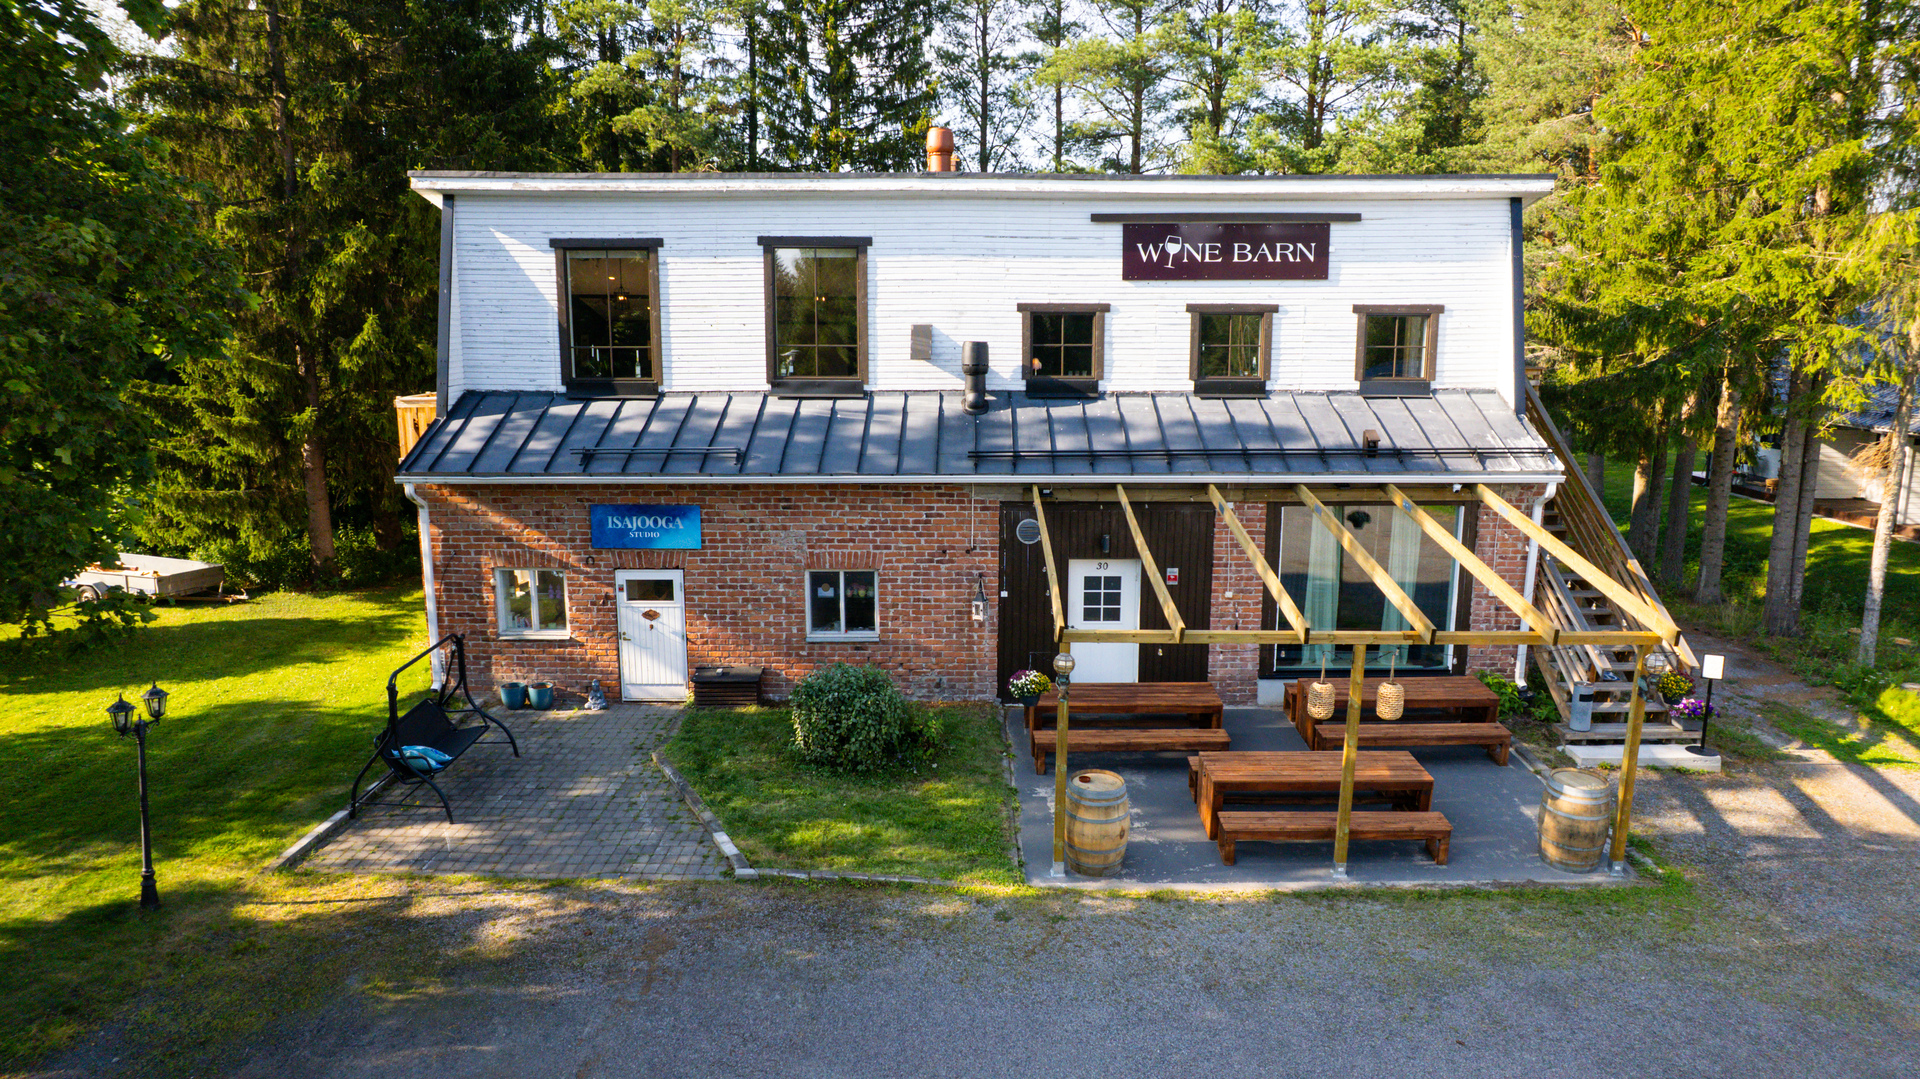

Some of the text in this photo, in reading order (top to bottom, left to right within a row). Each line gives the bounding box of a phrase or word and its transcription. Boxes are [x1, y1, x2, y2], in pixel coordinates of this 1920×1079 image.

[1232, 242, 1317, 263] BARN
[607, 515, 684, 531] ISAJOOGA
[1096, 562, 1109, 571] 30
